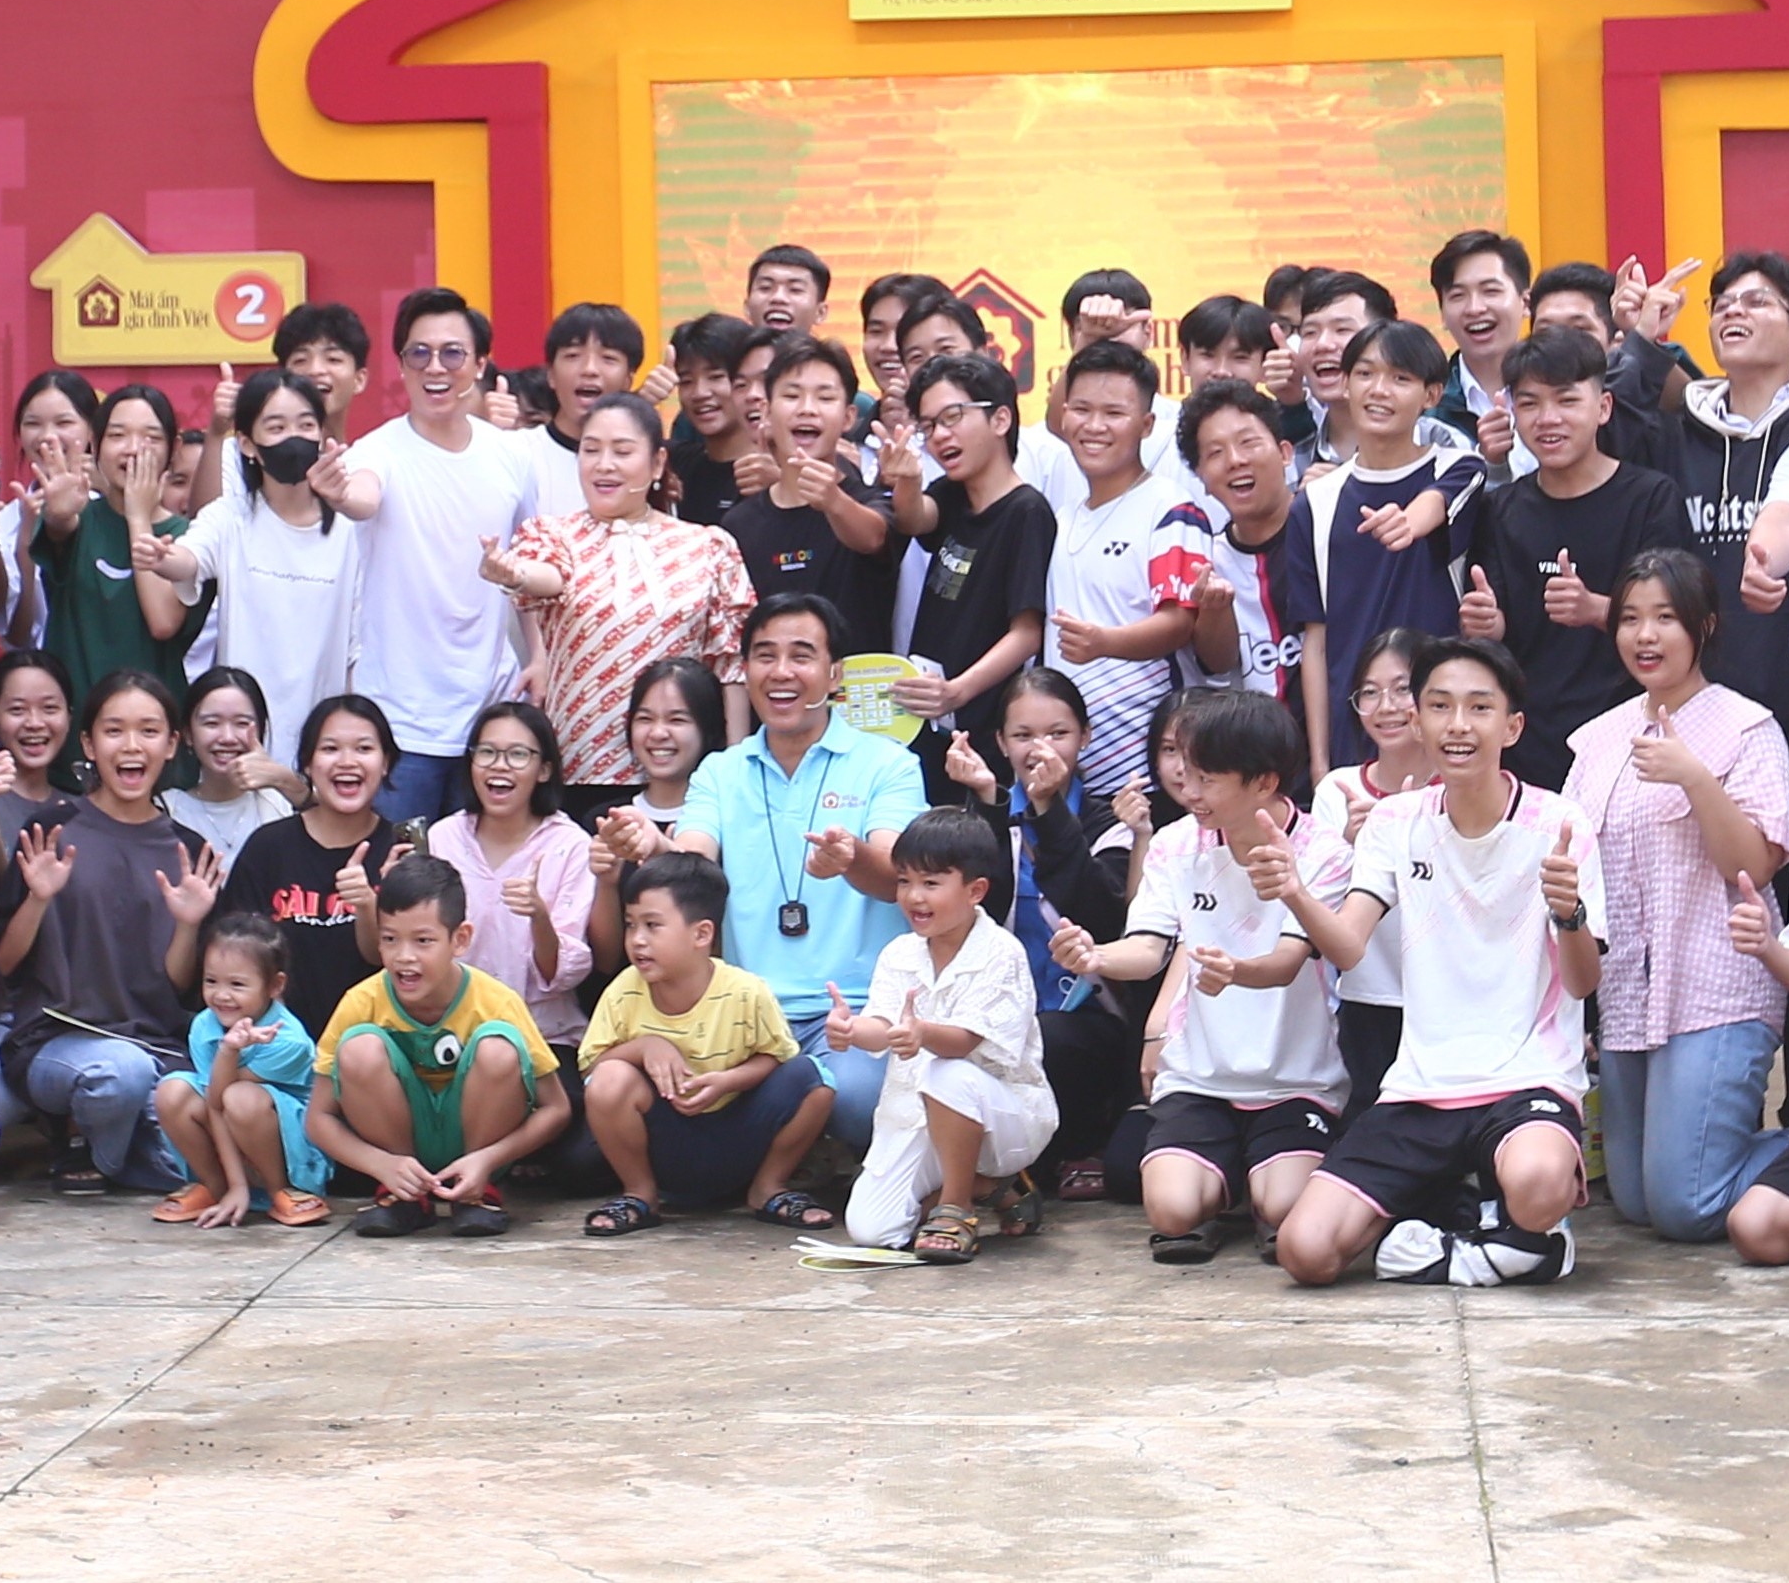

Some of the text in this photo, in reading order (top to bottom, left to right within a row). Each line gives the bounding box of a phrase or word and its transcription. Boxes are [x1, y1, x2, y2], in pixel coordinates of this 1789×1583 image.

[129, 290, 179, 309] Mái ấm
[234, 283, 267, 325] 2
[123, 308, 210, 333] gia đình Việt
[1239, 633, 1304, 678] Jee
